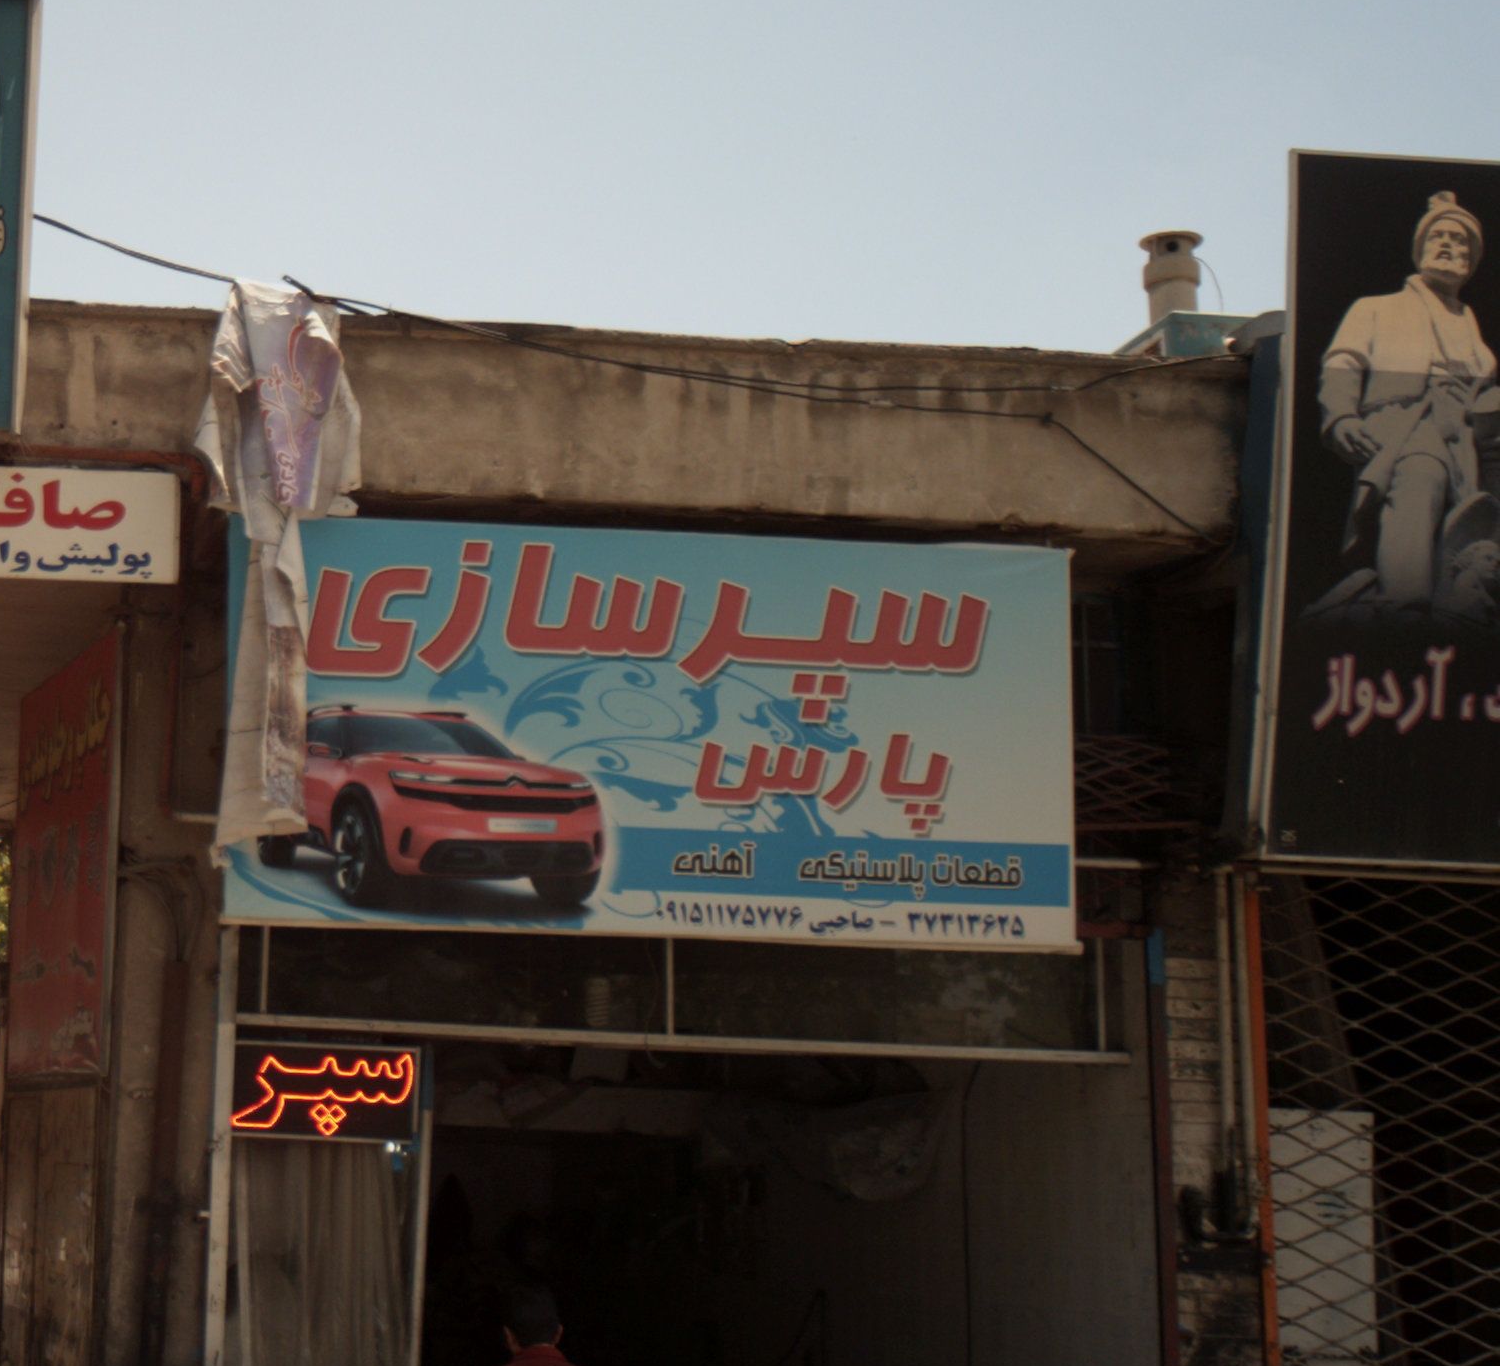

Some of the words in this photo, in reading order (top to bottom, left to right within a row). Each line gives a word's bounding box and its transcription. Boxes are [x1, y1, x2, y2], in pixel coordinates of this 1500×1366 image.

[37, 542, 153, 579] پولیش
[1311, 643, 1457, 738] آردواز
[693, 732, 953, 838] پارس
[672, 841, 757, 879] آهنی
[799, 848, 926, 900] پلاستیکی
[930, 852, 1023, 890] قطعات
[229, 1052, 415, 1138] سپر
